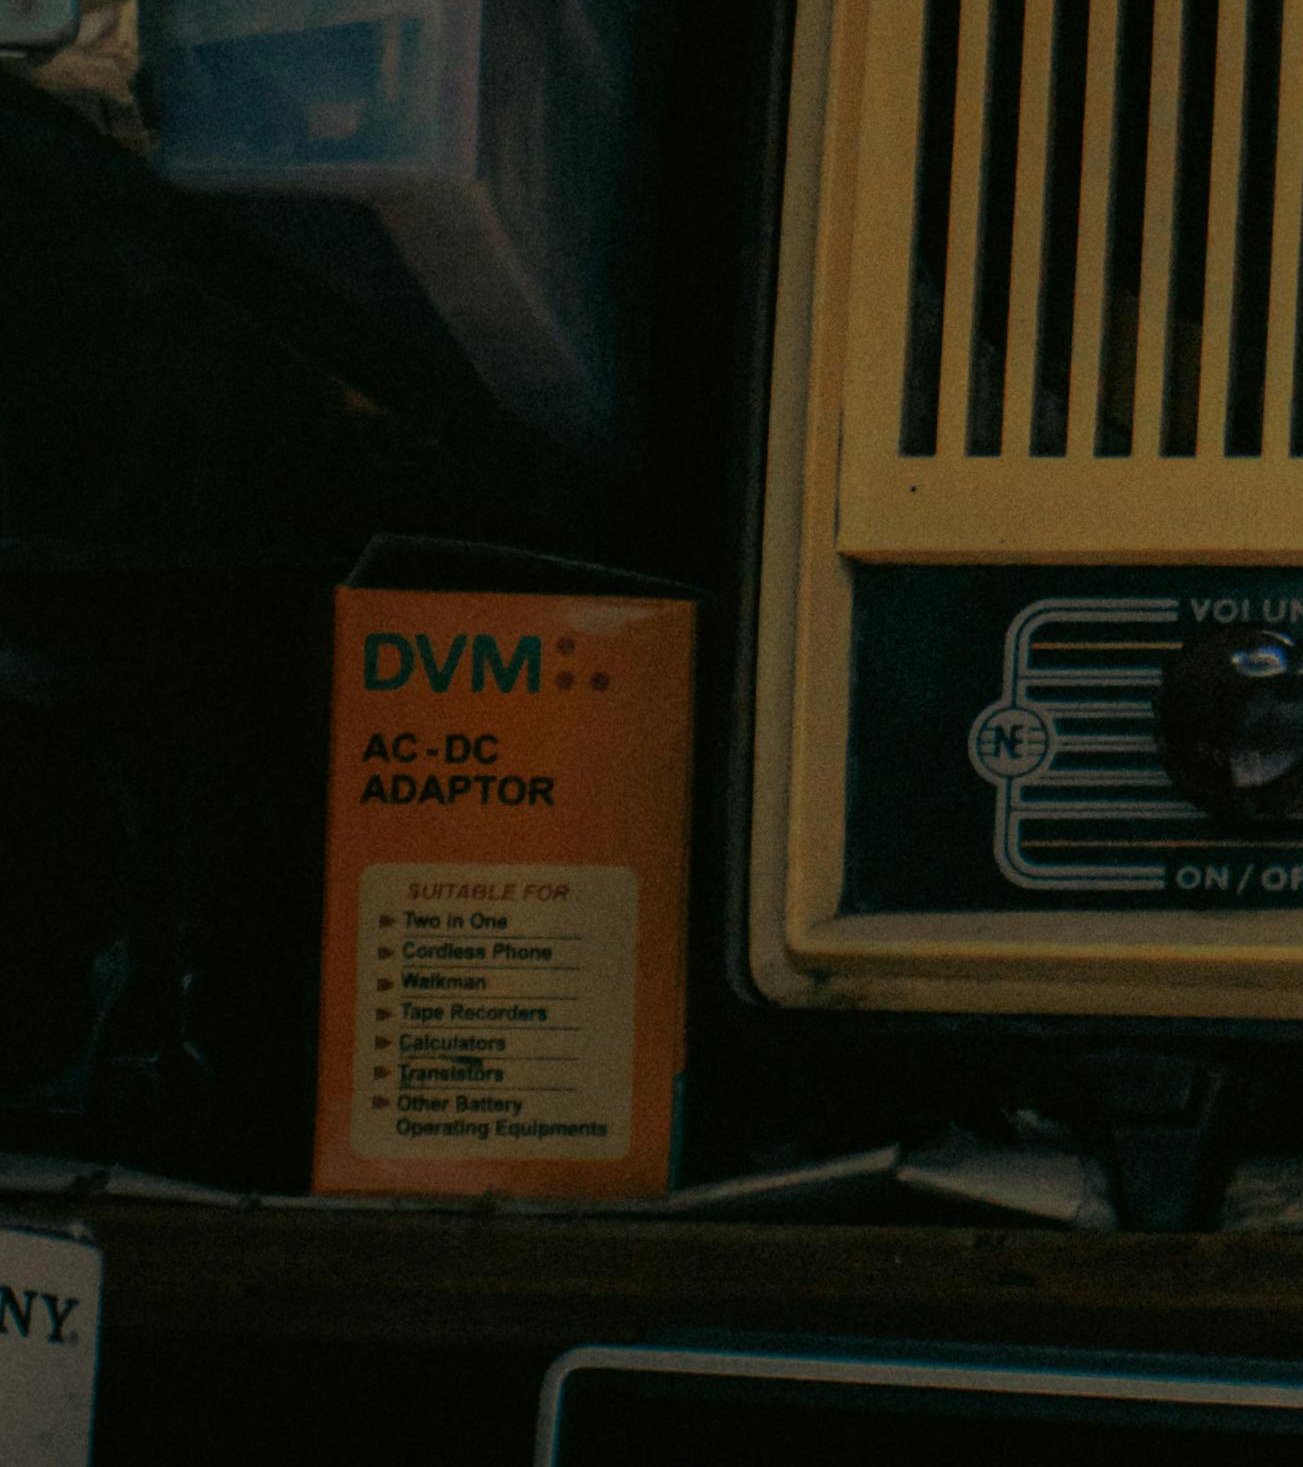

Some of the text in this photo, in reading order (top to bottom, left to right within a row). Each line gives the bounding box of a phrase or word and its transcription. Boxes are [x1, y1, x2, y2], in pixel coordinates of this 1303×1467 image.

[364, 633, 542, 693] DVM
[360, 775, 555, 807] ADAPTOR
[408, 882, 570, 901] SUITABLE FOR
[403, 911, 508, 930] Two in One
[402, 942, 553, 961] Cordless Phone
[401, 972, 487, 990] Walkman
[401, 1002, 548, 1022] Tape Recorders
[399, 1033, 506, 1052] Calculators
[399, 1062, 504, 1082] Transistors
[396, 1095, 523, 1116] Other Battery
[395, 1118, 608, 1140] Operating Equipments
